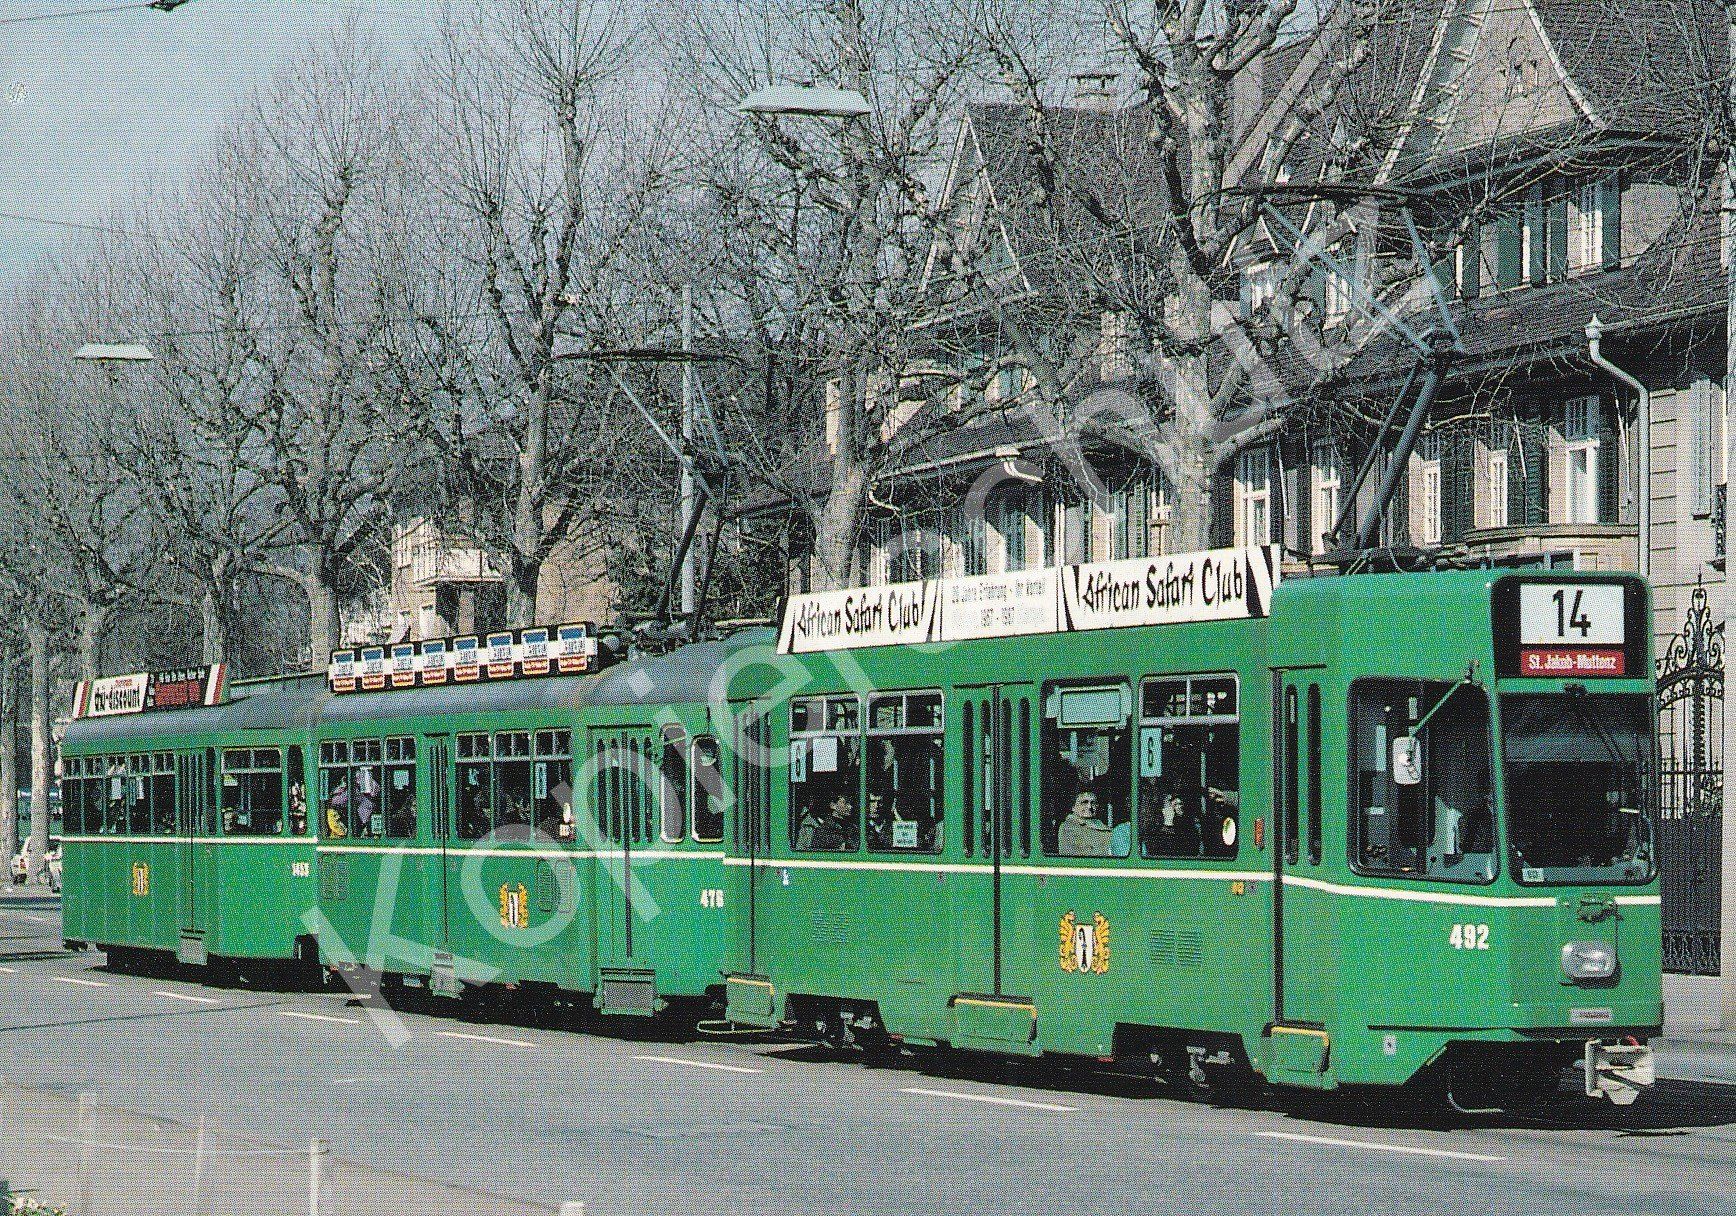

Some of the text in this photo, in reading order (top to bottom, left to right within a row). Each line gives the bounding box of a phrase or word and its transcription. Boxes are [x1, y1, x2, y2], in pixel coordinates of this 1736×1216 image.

[1082, 557, 1243, 613] African Safari Club
[797, 590, 919, 637] African Safari Club
[1552, 589, 1592, 637] 14
[1449, 923, 1490, 950] 492
